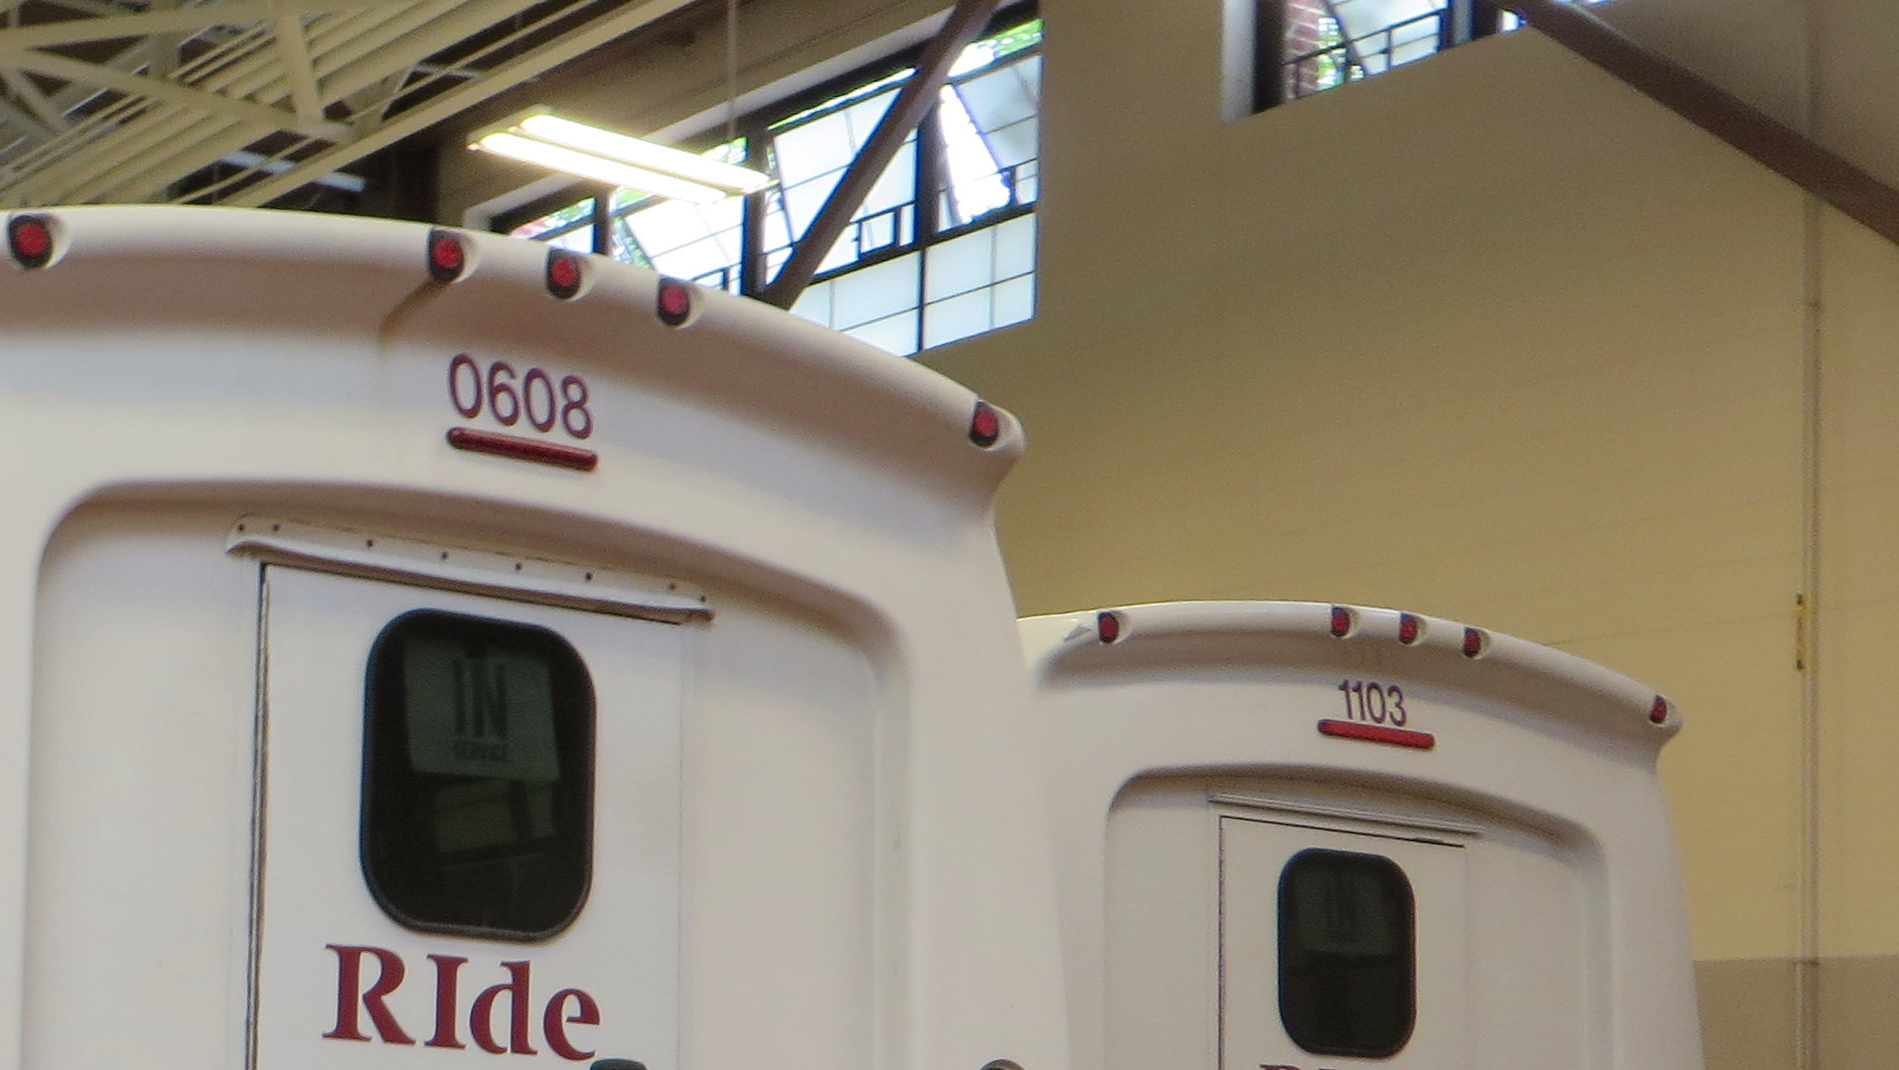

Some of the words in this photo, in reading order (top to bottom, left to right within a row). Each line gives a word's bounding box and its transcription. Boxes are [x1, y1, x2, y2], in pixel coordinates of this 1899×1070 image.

[449, 353, 593, 439] 0608
[1338, 679, 1406, 727] 1103
[322, 944, 601, 1061] RIde
